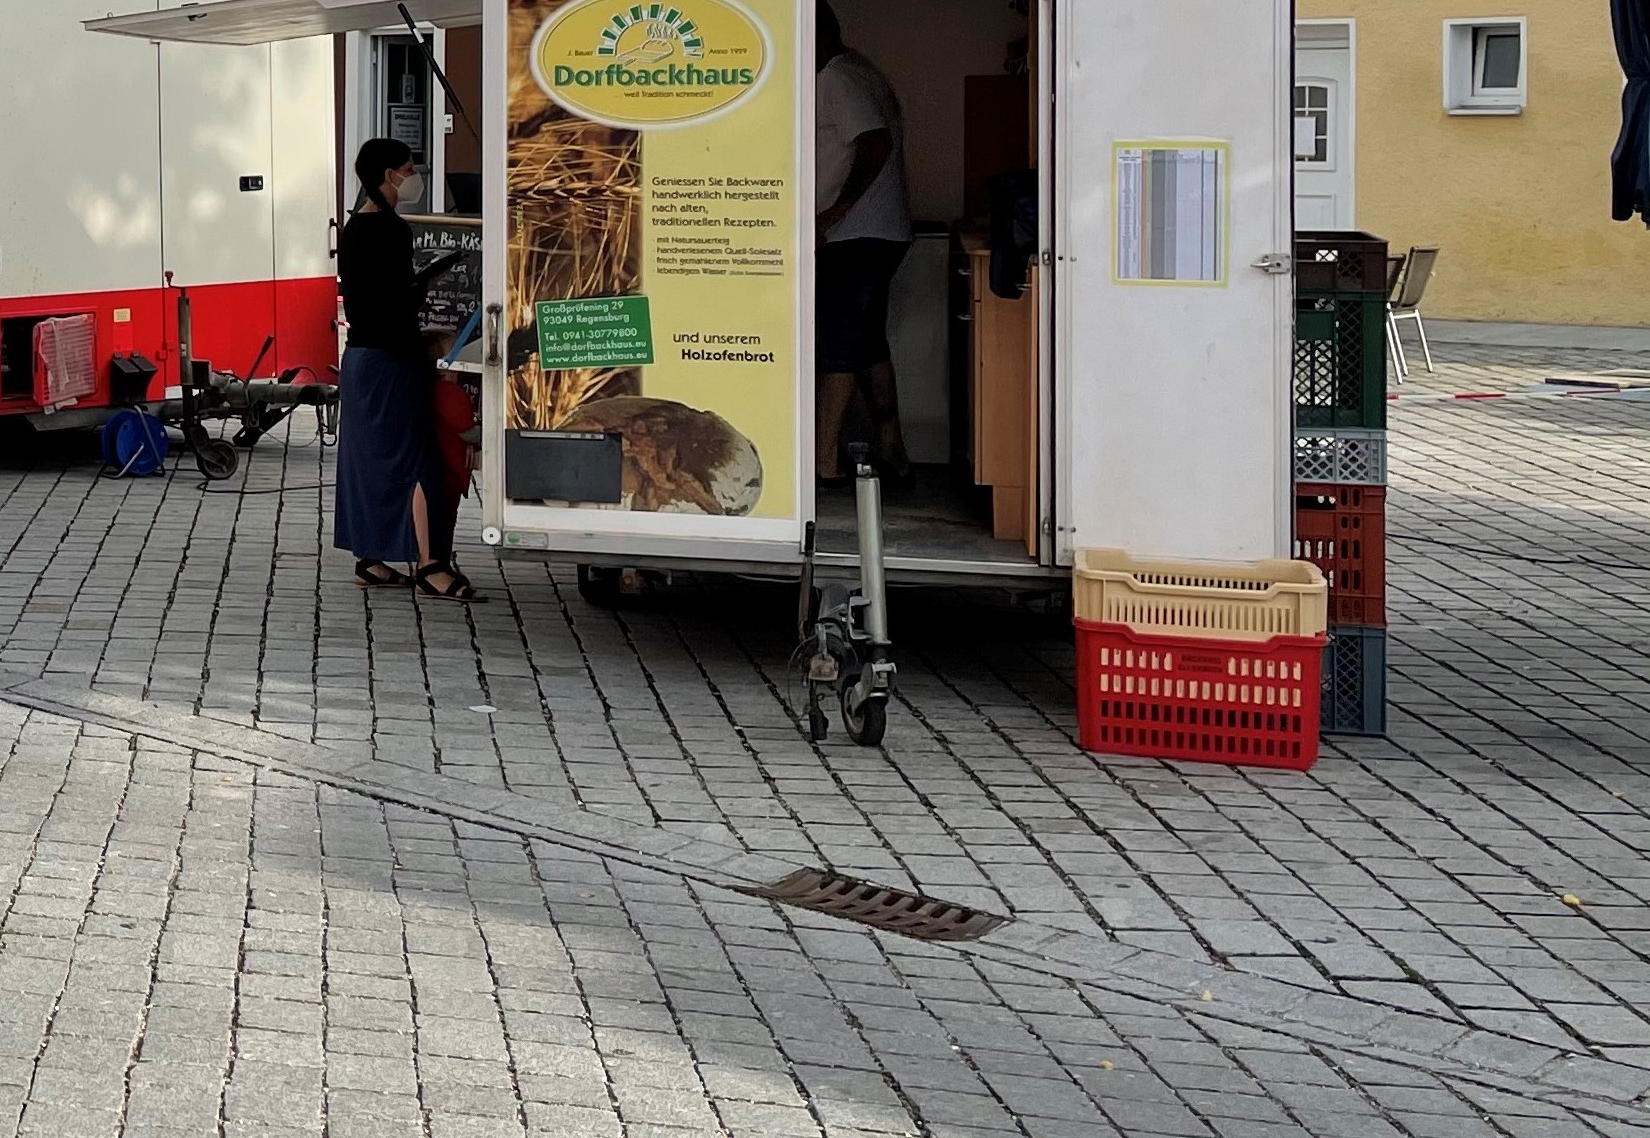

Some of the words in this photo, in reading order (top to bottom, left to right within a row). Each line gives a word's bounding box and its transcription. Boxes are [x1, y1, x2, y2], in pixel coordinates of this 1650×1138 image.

[554, 63, 755, 87] Dorfbackhaus
[642, 90, 674, 98] Tradition
[652, 176, 706, 187] Geniessen
[708, 176, 724, 187] Sie
[726, 177, 784, 187] Backwaren
[652, 190, 722, 200] handwerklich
[724, 191, 780, 201] hergestellt
[652, 204, 677, 213] nach
[680, 204, 709, 214] alten,
[652, 217, 721, 227] traditionellen
[724, 218, 777, 229] Rezepten.
[542, 303, 609, 314] Großprüfening
[611, 301, 624, 311] 29
[543, 315, 574, 325] 93049
[576, 313, 630, 325] Regensburg
[544, 332, 559, 341] Tel.
[673, 332, 700, 343] und
[703, 334, 761, 345] unserem
[545, 340, 647, 353] info@dorfbackhaus.eu
[546, 351, 648, 363] www.dorfbackhaus.eu
[681, 349, 775, 363] Holzofenbrot
